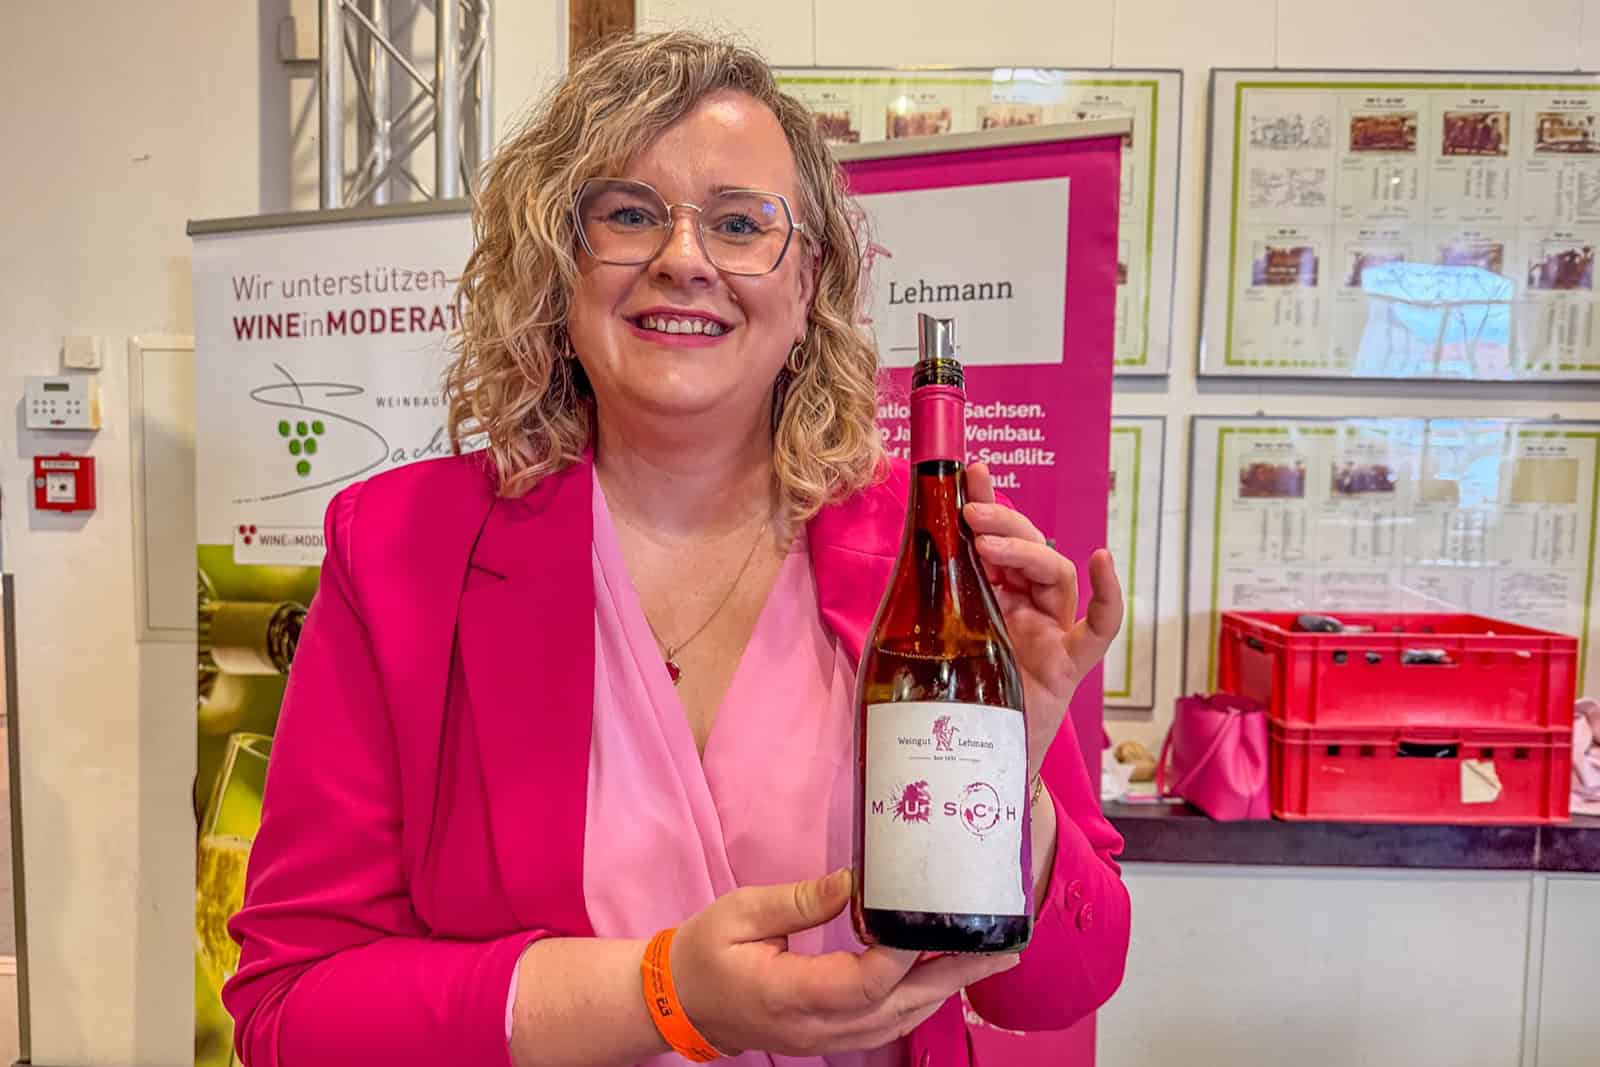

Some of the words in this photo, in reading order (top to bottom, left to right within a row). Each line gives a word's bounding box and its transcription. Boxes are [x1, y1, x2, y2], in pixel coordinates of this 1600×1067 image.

[232, 274, 272, 301] Wir
[281, 267, 447, 299] unterstützen
[888, 279, 1014, 305] Lehmann
[964, 400, 1046, 419] Sachsen.
[965, 447, 1055, 466] r-Seußlitz
[897, 736, 931, 747] Weingut
[958, 738, 994, 749] Lehmann
